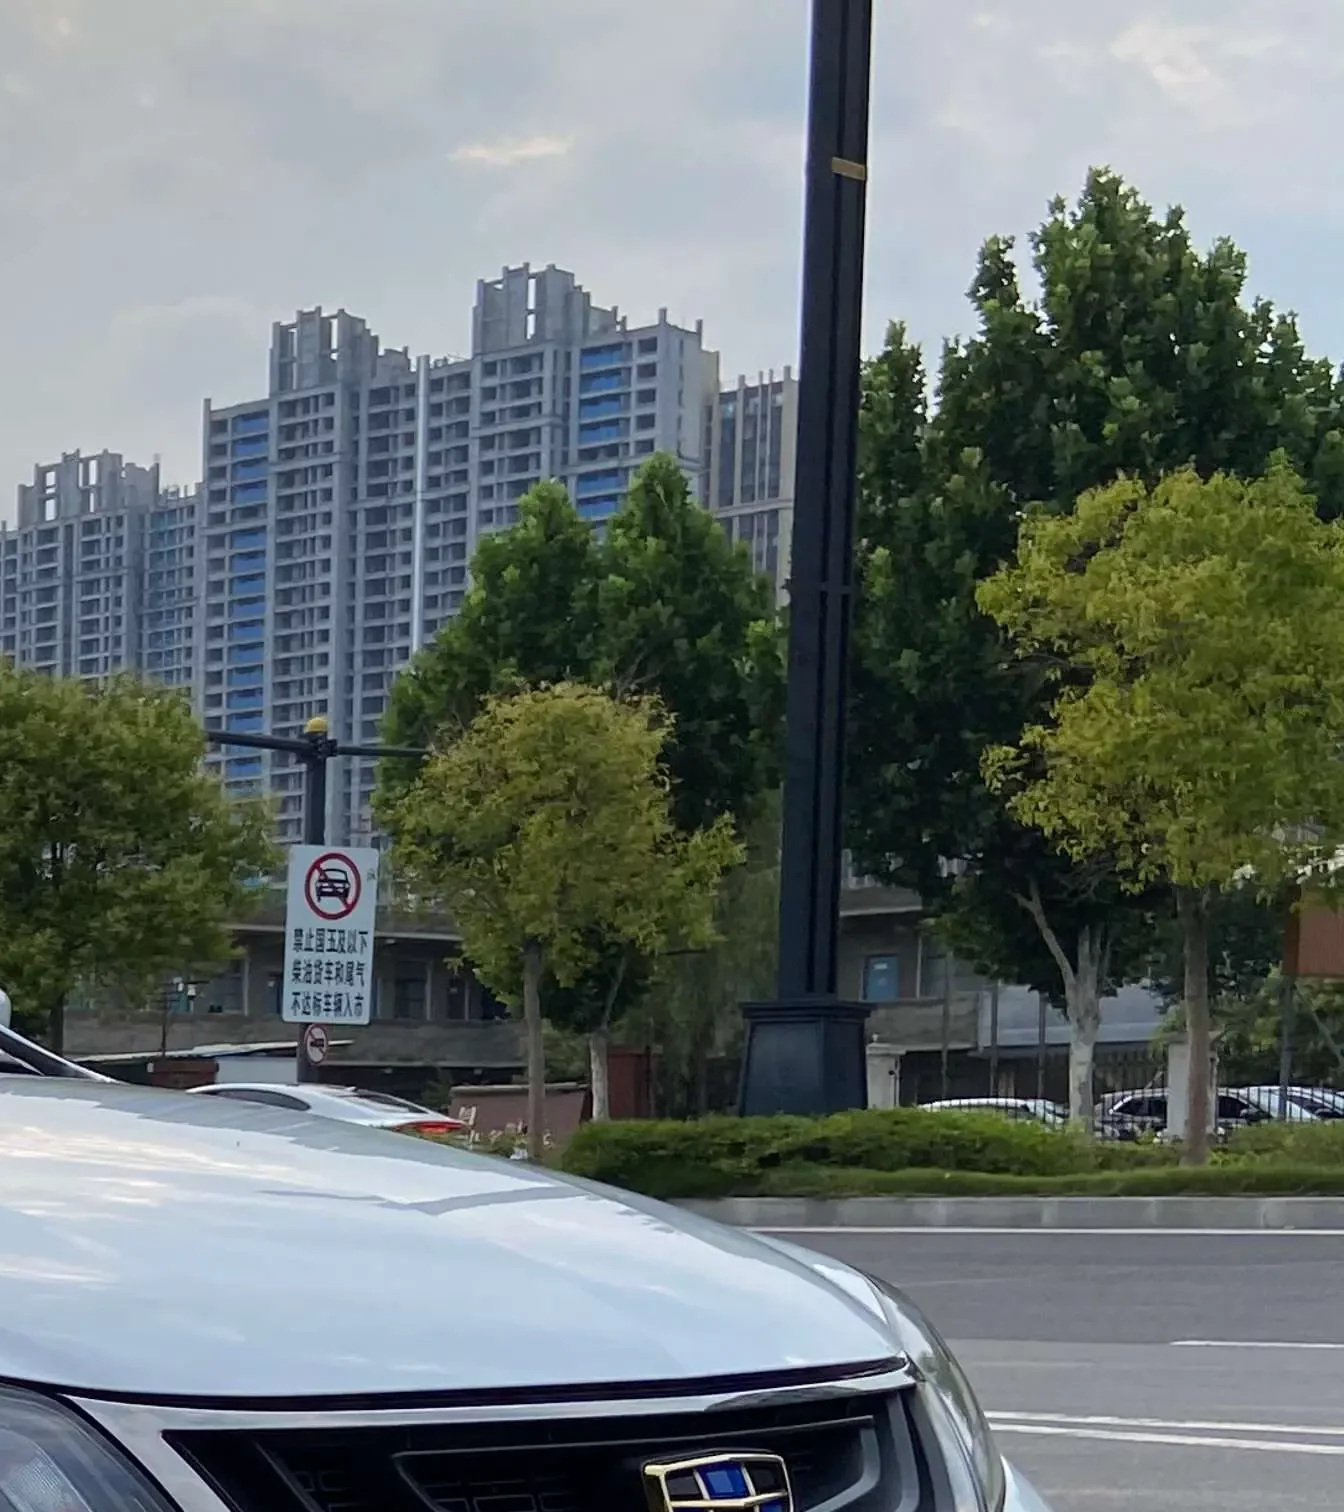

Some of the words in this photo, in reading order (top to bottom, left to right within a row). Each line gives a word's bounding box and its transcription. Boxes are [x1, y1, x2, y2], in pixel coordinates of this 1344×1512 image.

[291, 958, 366, 987] 柴油货车和尾气
[290, 991, 364, 1018] 不达标车辆入市
